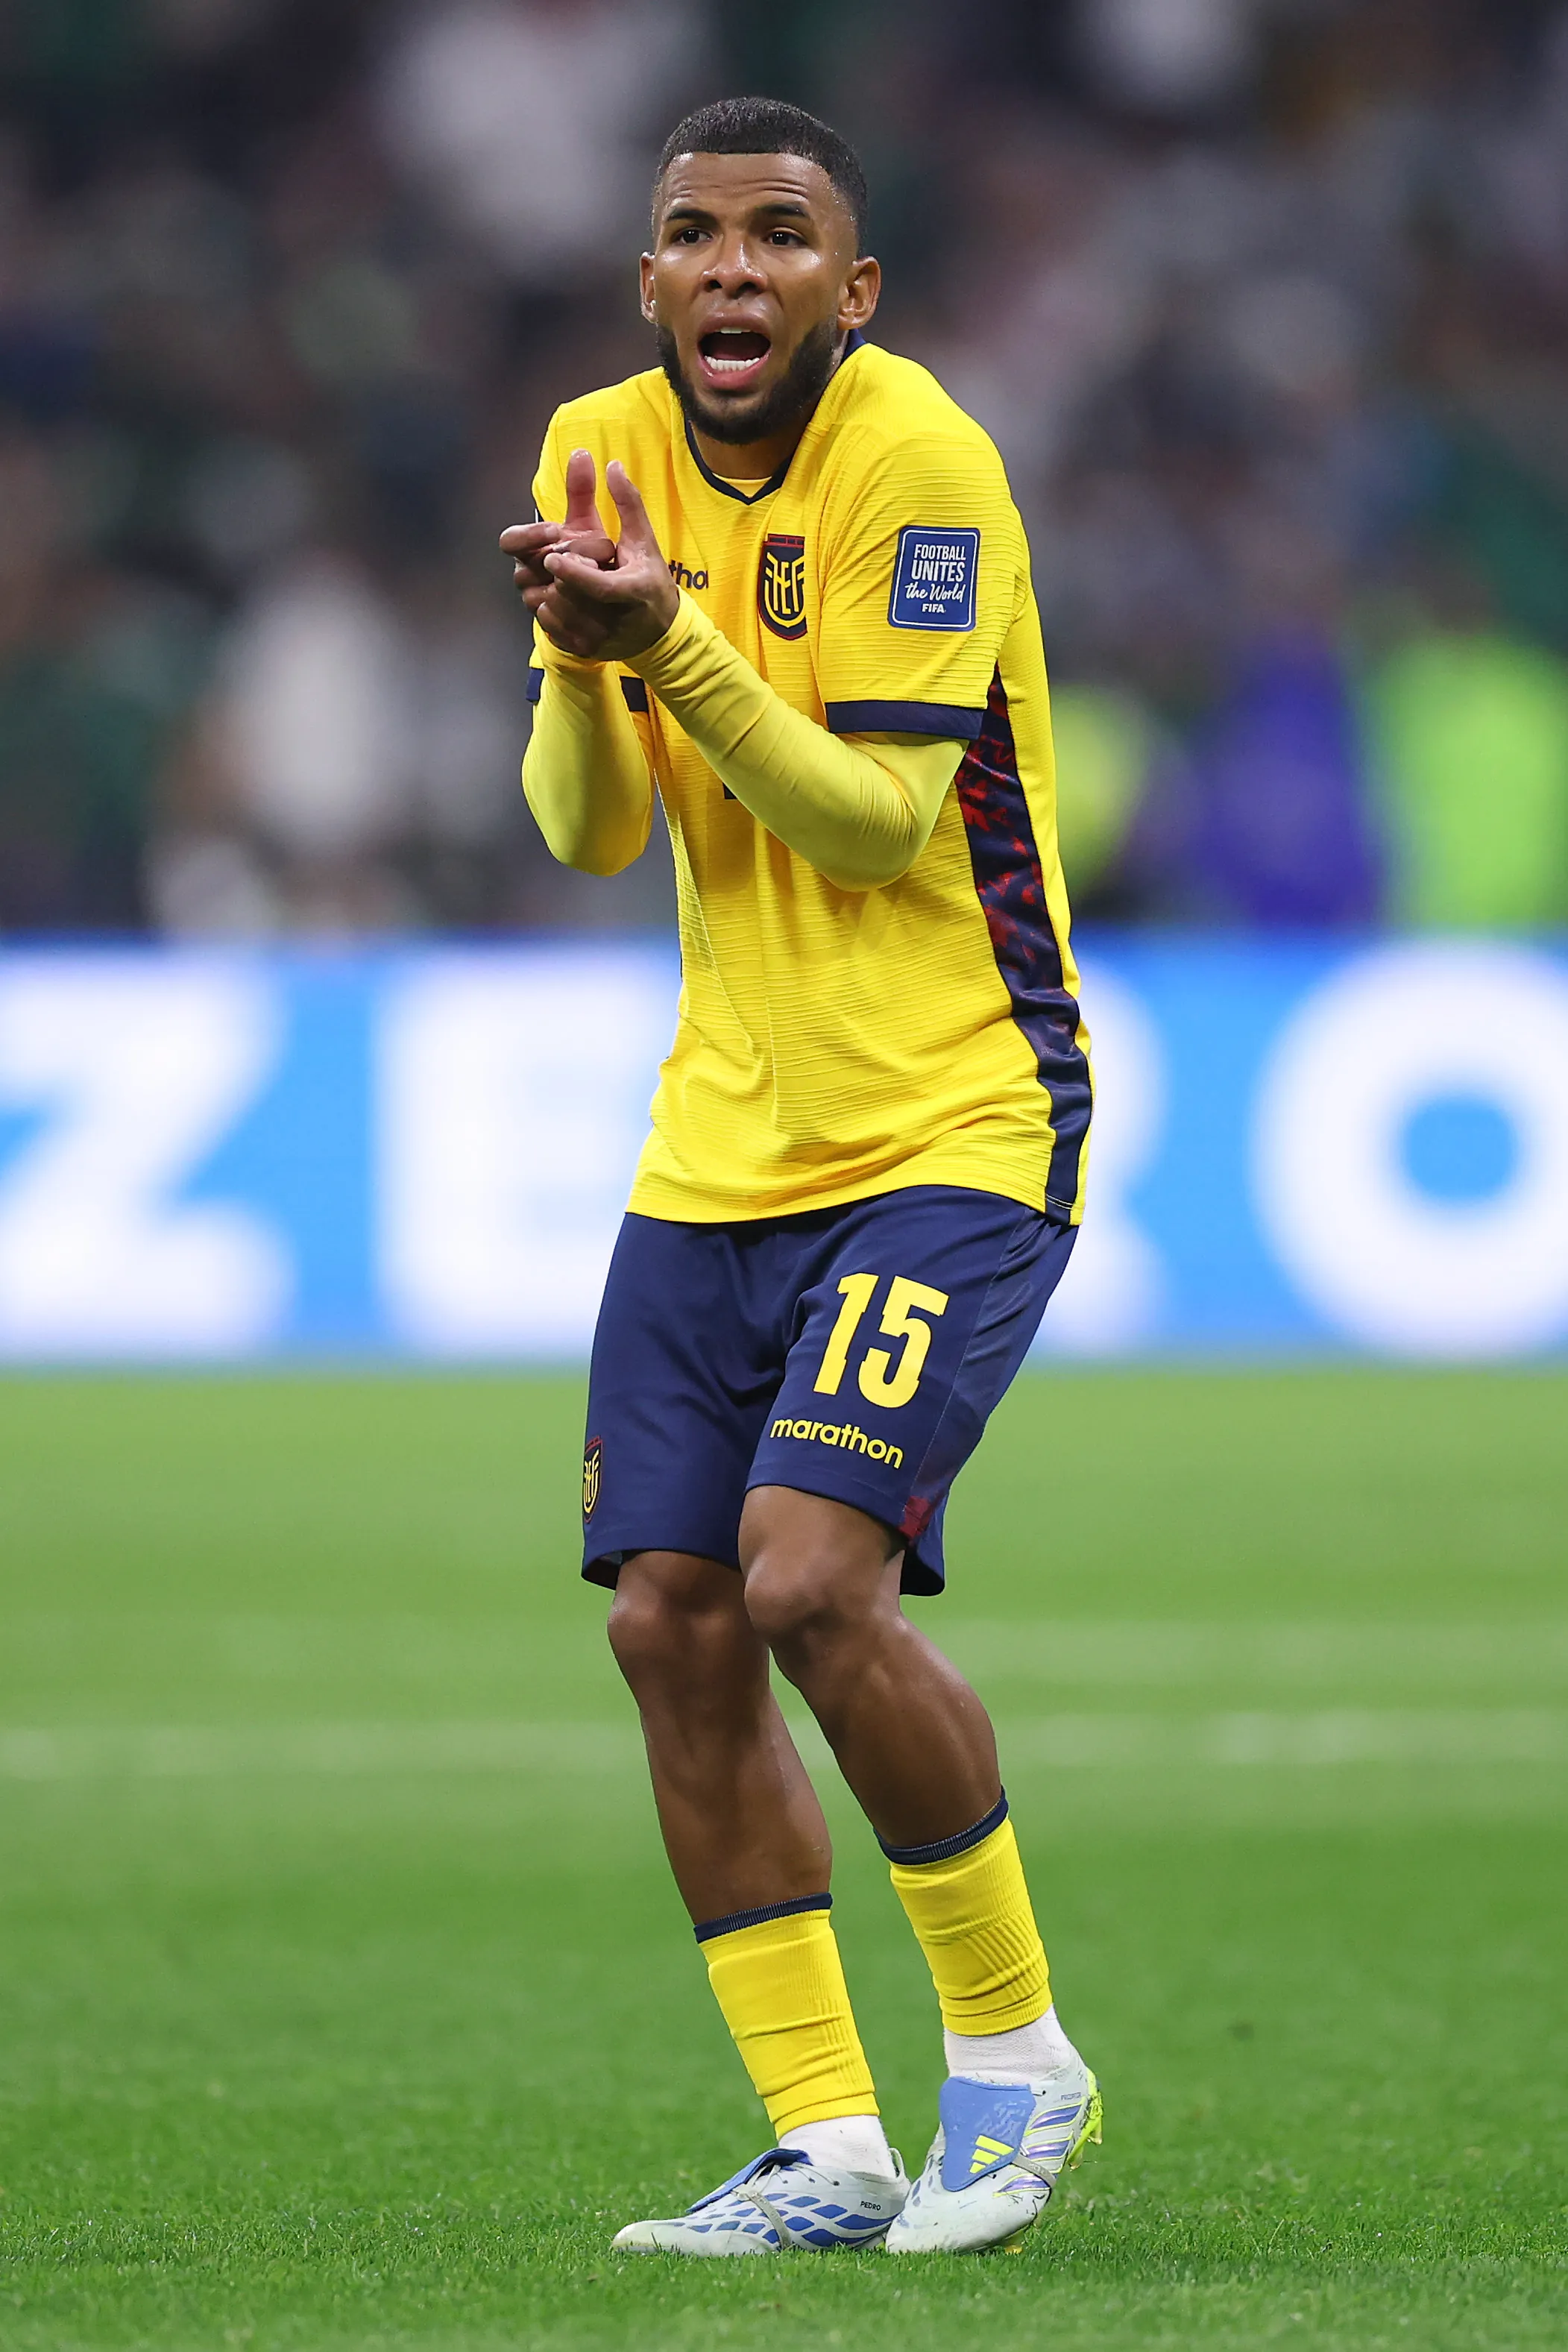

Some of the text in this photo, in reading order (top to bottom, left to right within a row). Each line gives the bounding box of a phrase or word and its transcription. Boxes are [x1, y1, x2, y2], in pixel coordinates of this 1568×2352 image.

[913, 544, 966, 561] FOOTBALL
[911, 559, 966, 582] UNITES
[904, 582, 966, 603] the World
[922, 603, 945, 613] FIFA
[0, 938, 1568, 1359] ZEO
[813, 1272, 949, 1408] 15
[769, 1418, 904, 1469] marathon
[860, 2201, 881, 2211] PEDRO
